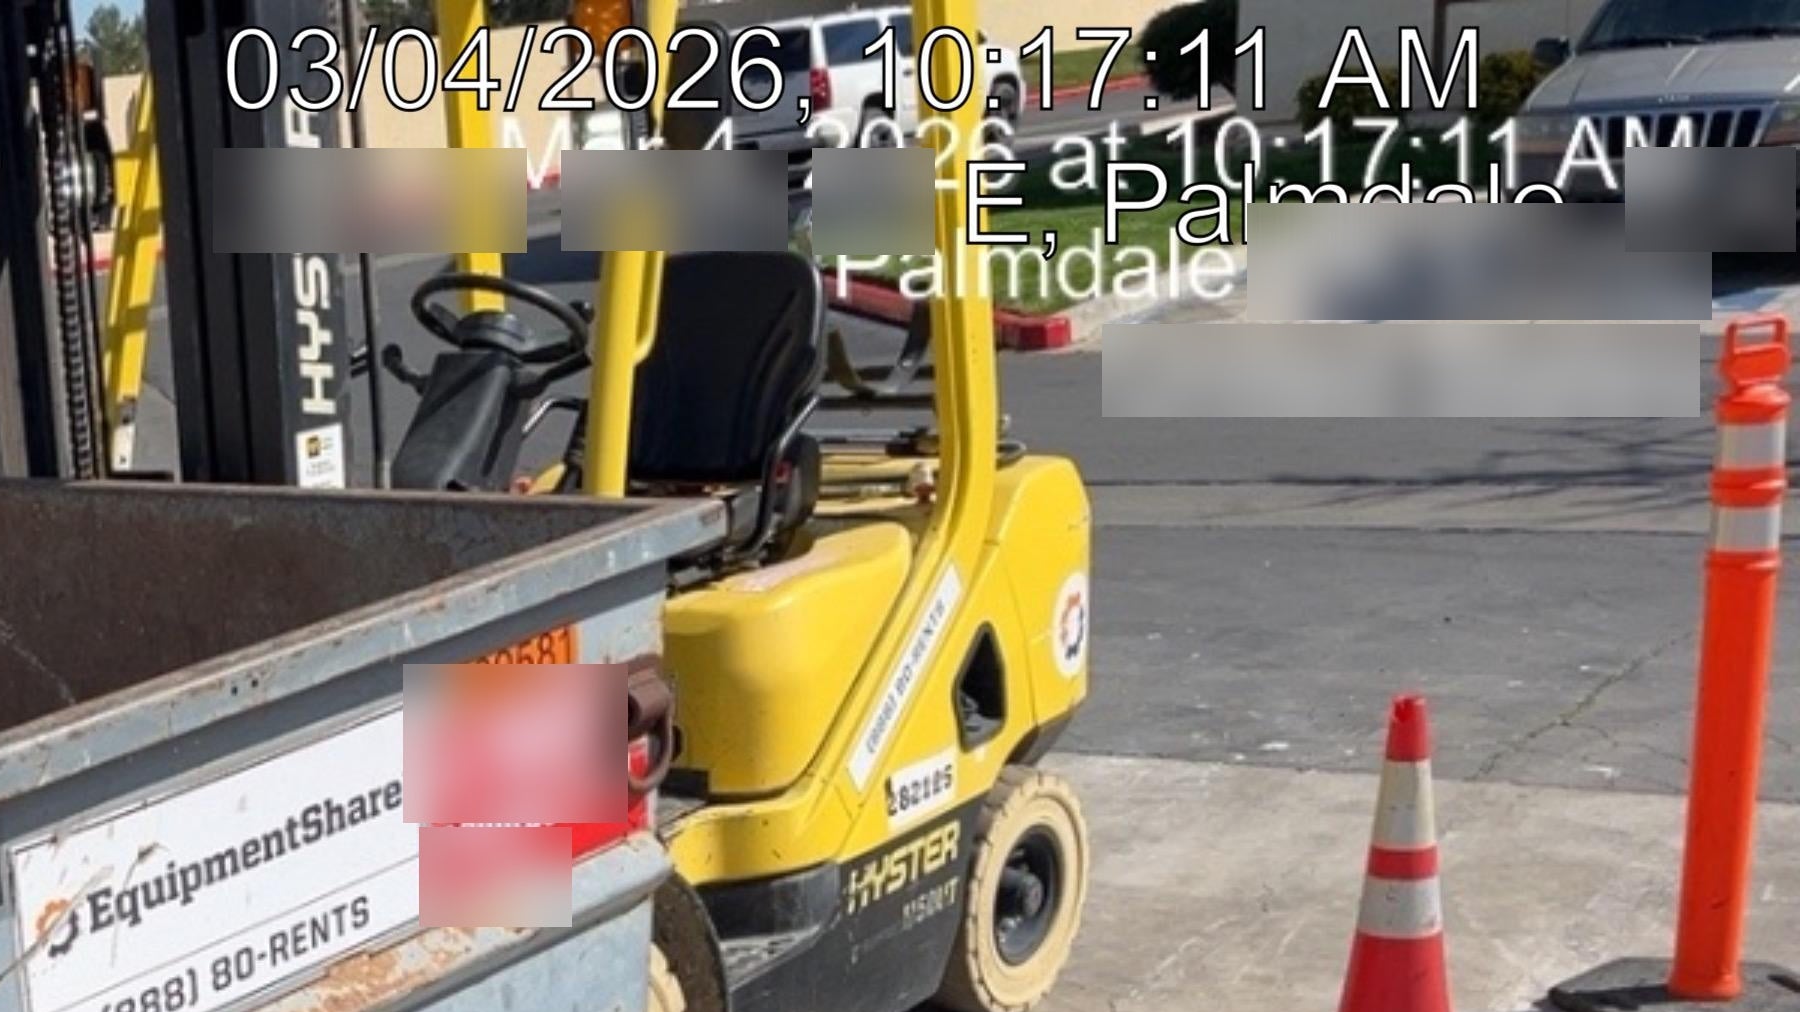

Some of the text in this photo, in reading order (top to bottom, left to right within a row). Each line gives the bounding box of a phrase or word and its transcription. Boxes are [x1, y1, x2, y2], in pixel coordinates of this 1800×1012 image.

[285, 96, 337, 414] HYSR
[86, 779, 403, 933] EquipmentShare
[847, 819, 960, 915] HYSTER
[210, 896, 371, 991] 80-RENTS
